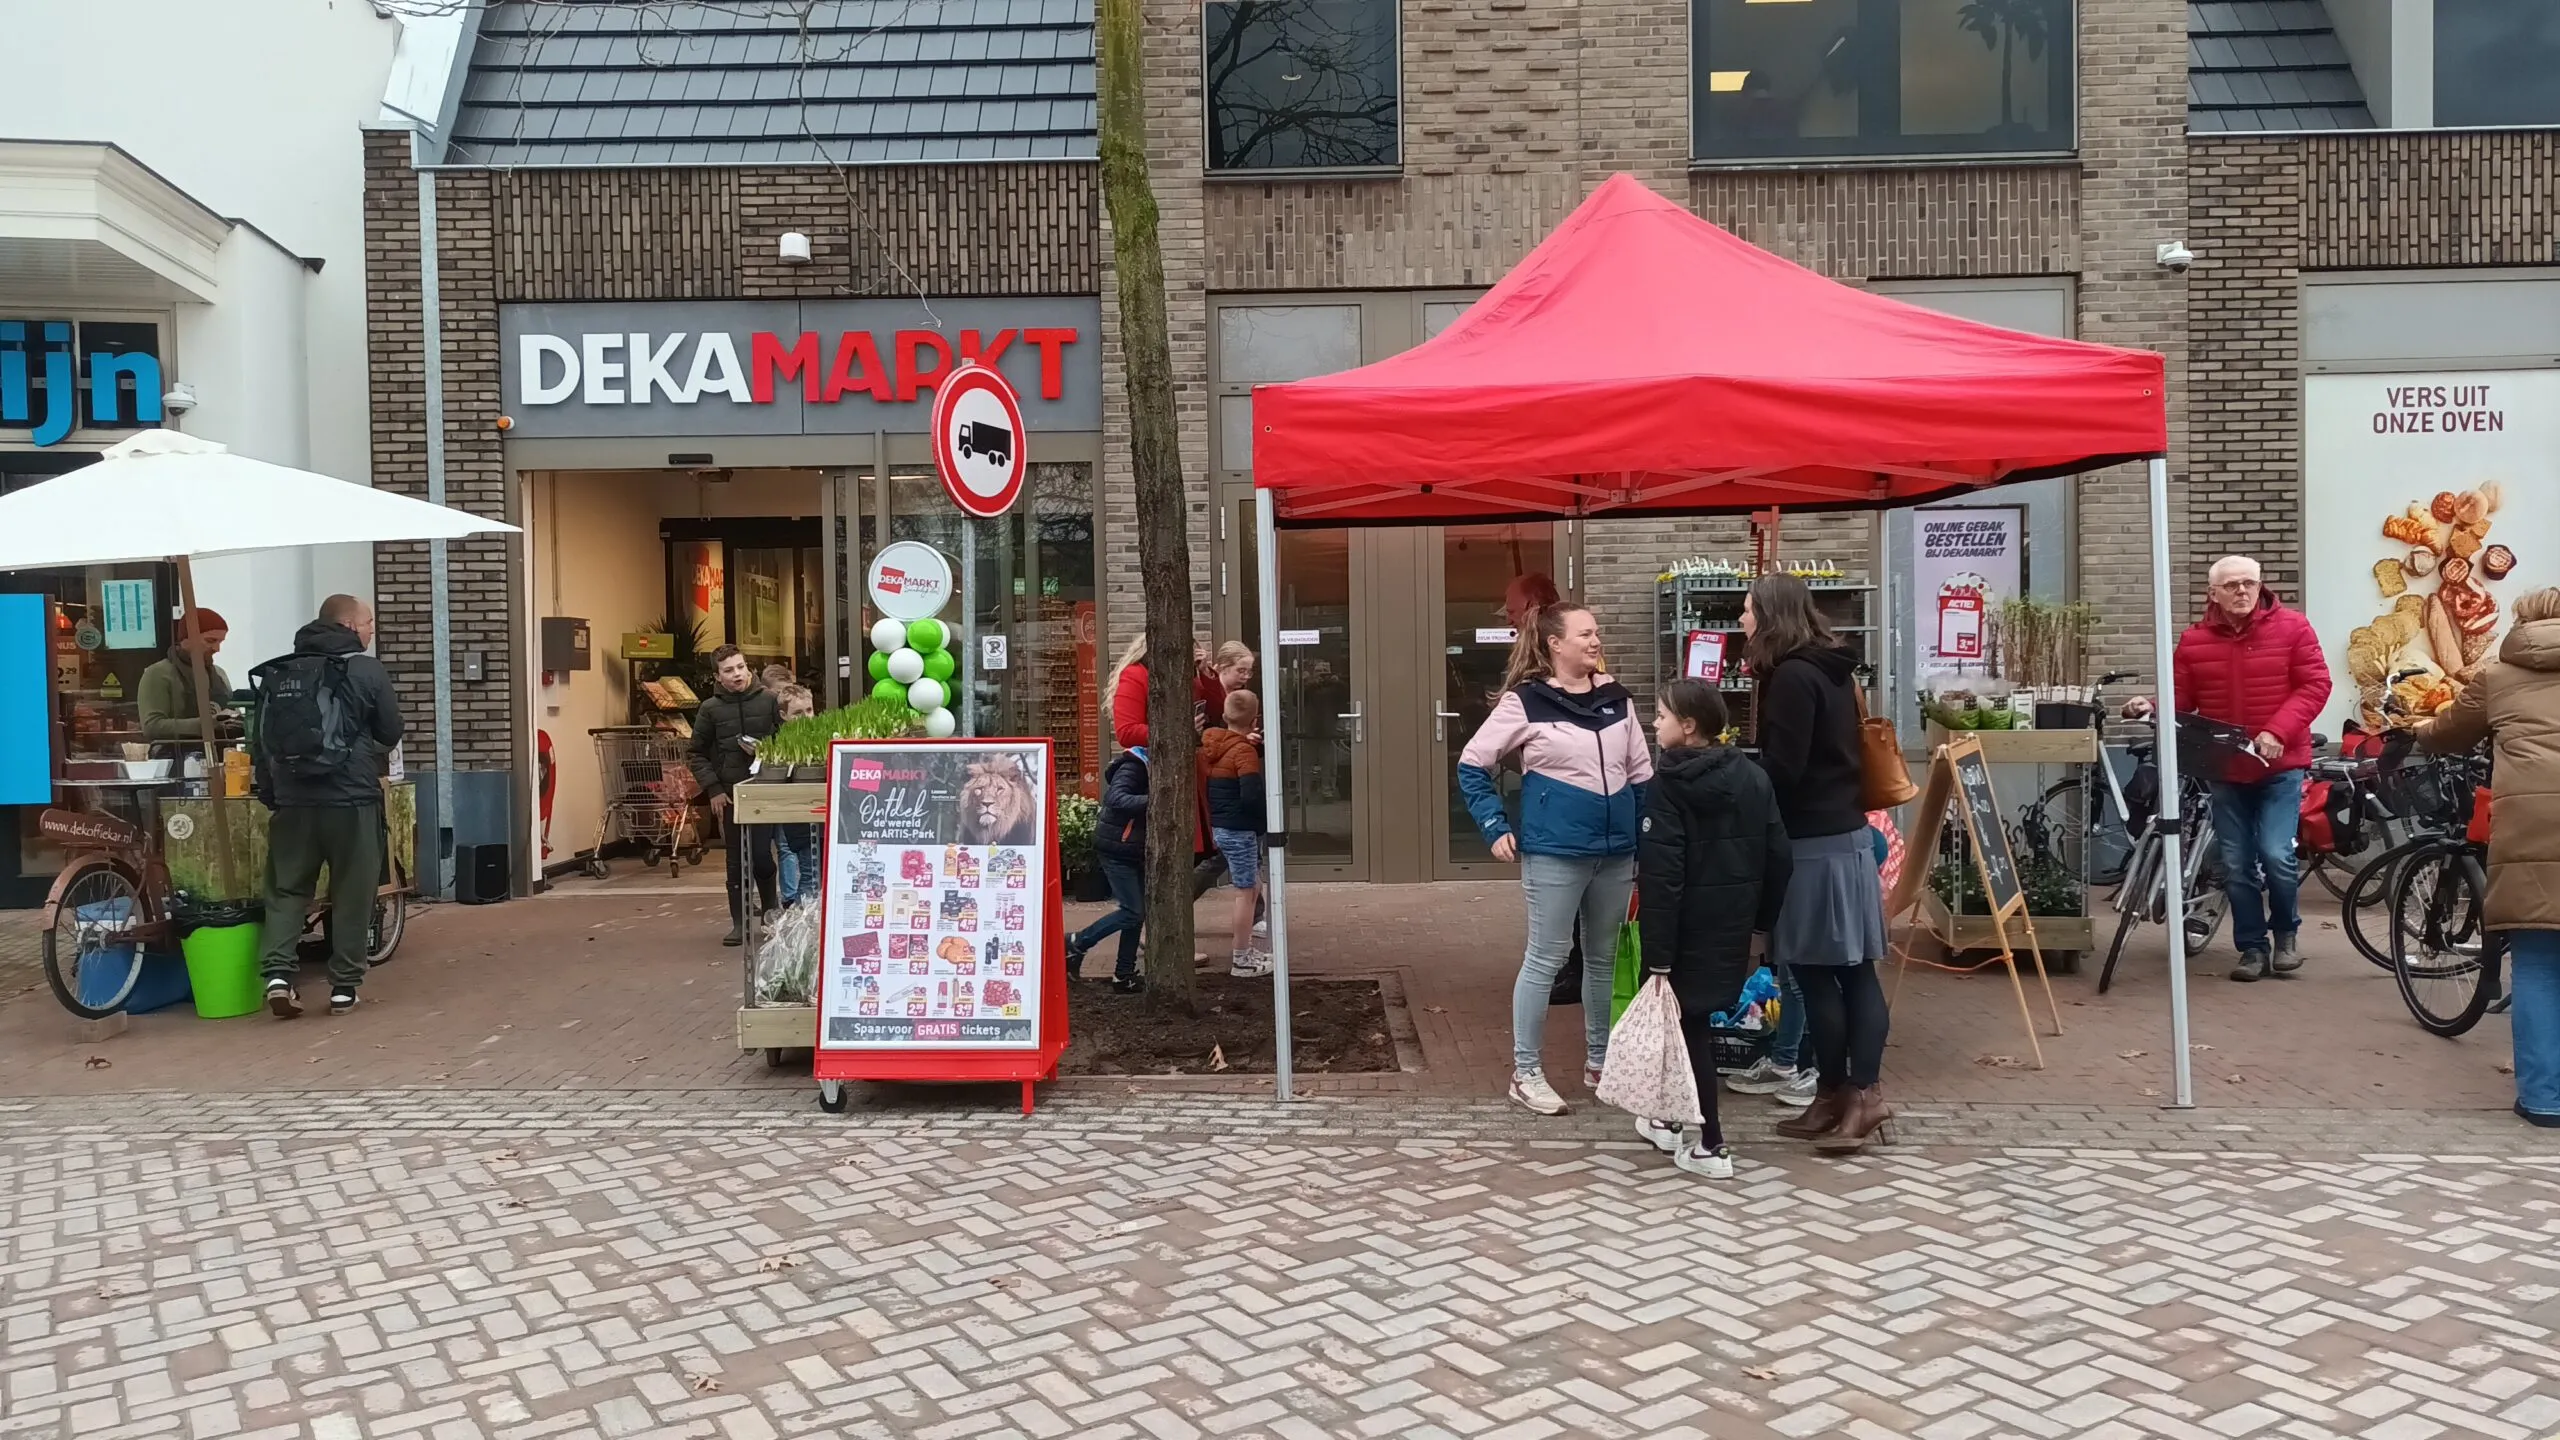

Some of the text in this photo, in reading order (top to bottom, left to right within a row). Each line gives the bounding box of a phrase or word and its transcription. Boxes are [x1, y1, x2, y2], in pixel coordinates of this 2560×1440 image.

[518, 328, 1077, 404] DEKAMARKT
[0, 322, 161, 447] ijn
[2387, 385, 2490, 408] VERS UIT
[2373, 410, 2503, 433] ONZE OVEN
[1924, 521, 2005, 533] ONLINE GEBAK
[1925, 532, 2007, 547] BESTELLEN
[1925, 547, 2005, 558] BIJ DEKAMARKT
[880, 575, 940, 588] DEKAMARKT
[851, 769, 927, 781] DEKAMARKT
[859, 787, 929, 824] Ontdek
[873, 818, 921, 828] de wereld
[44, 820, 133, 844] www.dekoffiekar.nl
[860, 828, 935, 839] van ARTIS-Park
[854, 1022, 1000, 1036] Spaar voor GRATIS tickets
